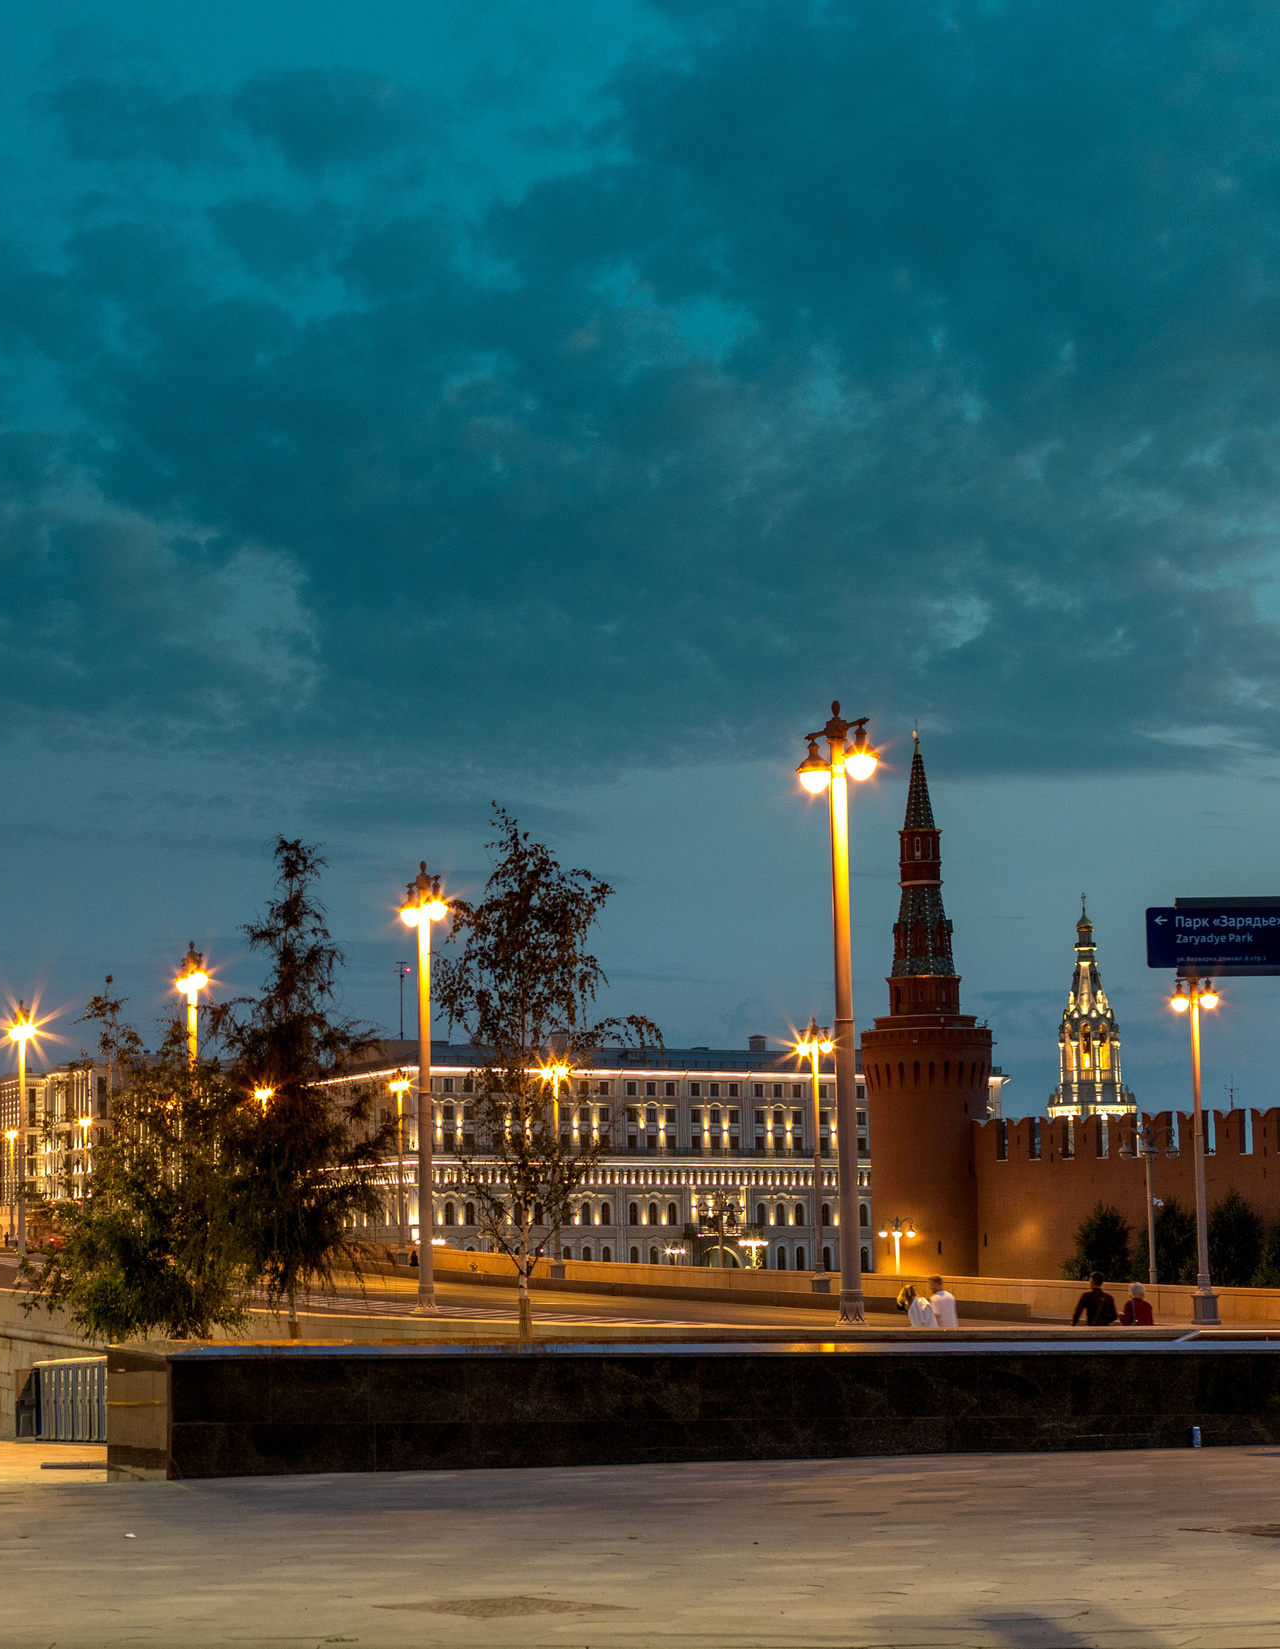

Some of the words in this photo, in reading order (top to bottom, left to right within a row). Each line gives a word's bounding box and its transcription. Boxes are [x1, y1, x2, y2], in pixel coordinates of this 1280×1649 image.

[1175, 916, 1210, 930] Парк
[1176, 933, 1226, 945] Zaryadye
[1228, 933, 1253, 942] Park
